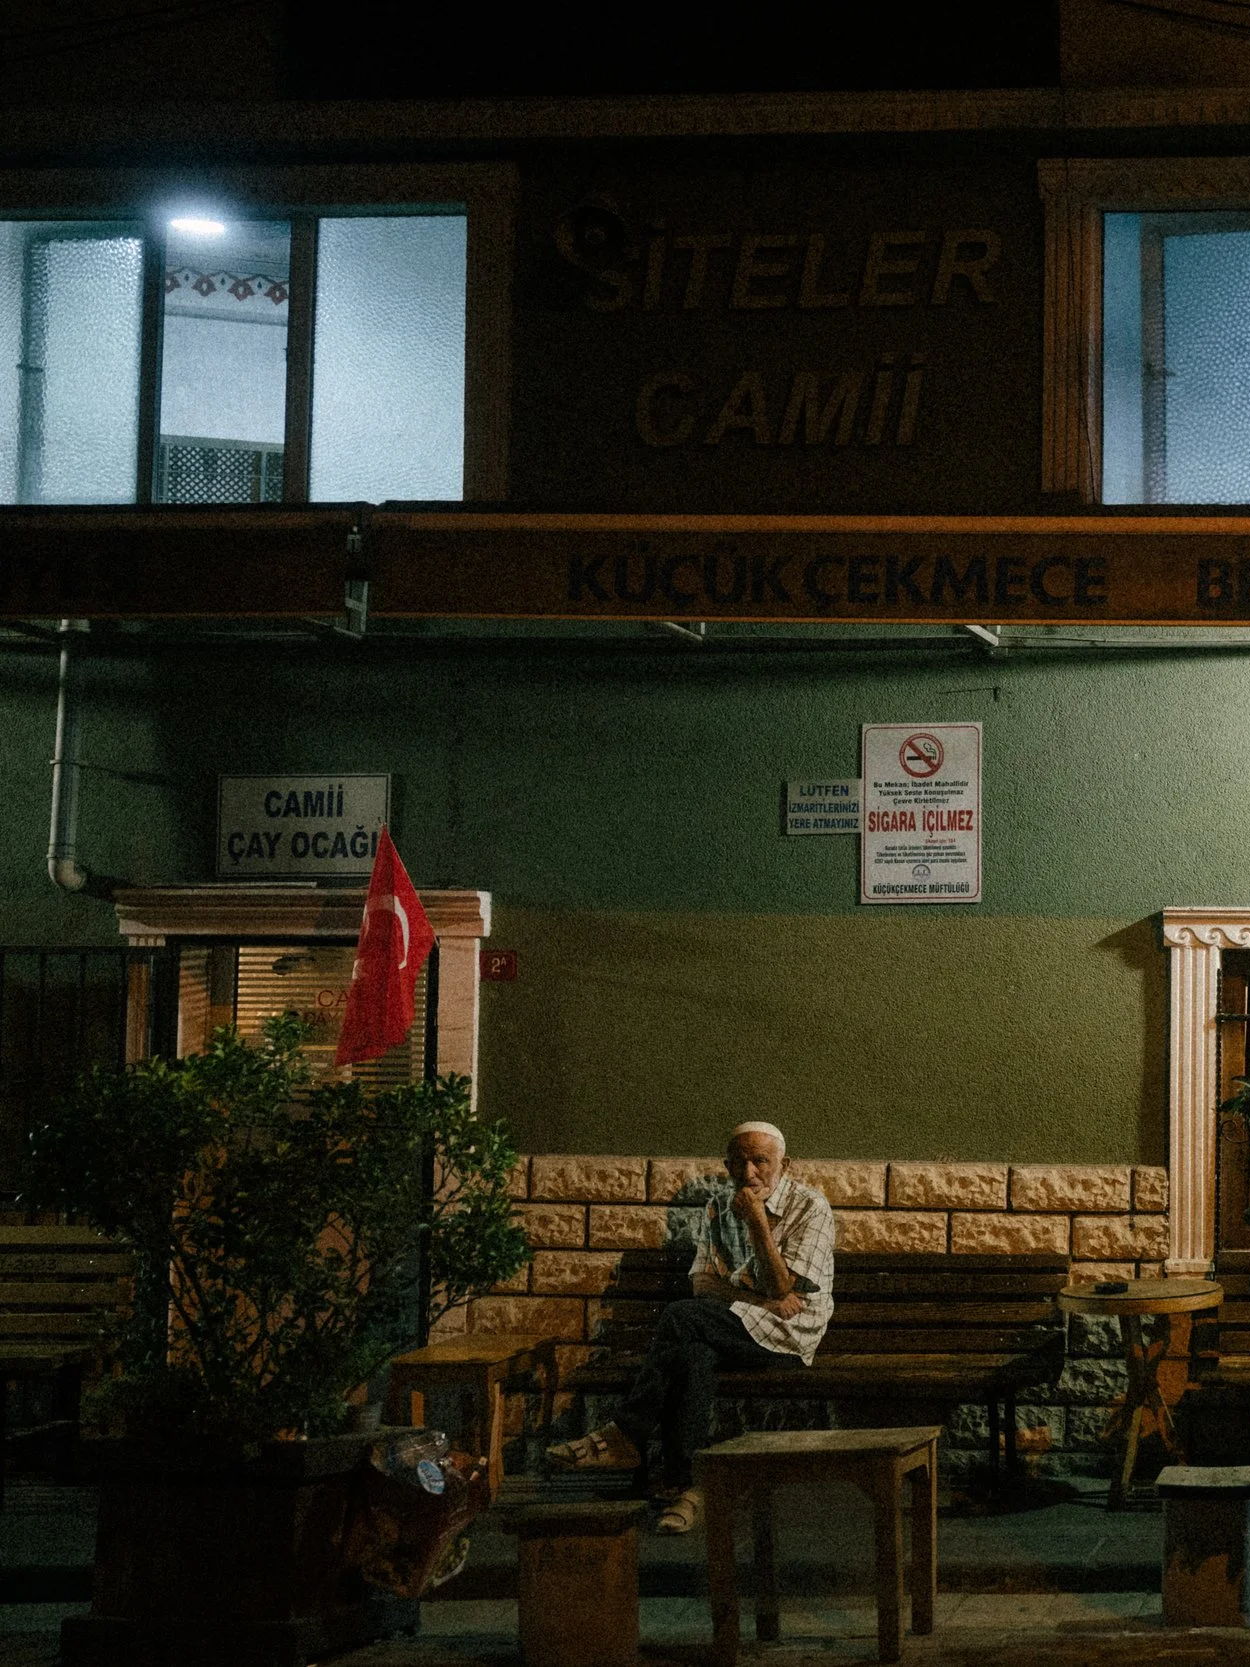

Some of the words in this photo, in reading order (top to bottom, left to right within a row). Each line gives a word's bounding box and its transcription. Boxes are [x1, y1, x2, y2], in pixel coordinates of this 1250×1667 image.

[637, 351, 927, 448] CAMİİ
[264, 784, 344, 817] CAMİİ
[789, 818, 811, 829] YERE
[813, 818, 859, 829] ATMAYINIZ
[868, 806, 916, 832] SİGARA
[922, 804, 974, 838] İÇİLMEZ
[227, 831, 282, 865] ÇAY
[290, 825, 379, 859] OCAĞI
[873, 882, 927, 897] KÜÇÜKÇEKMECE
[928, 881, 970, 894] MÜFTÜLÜĞÜ
